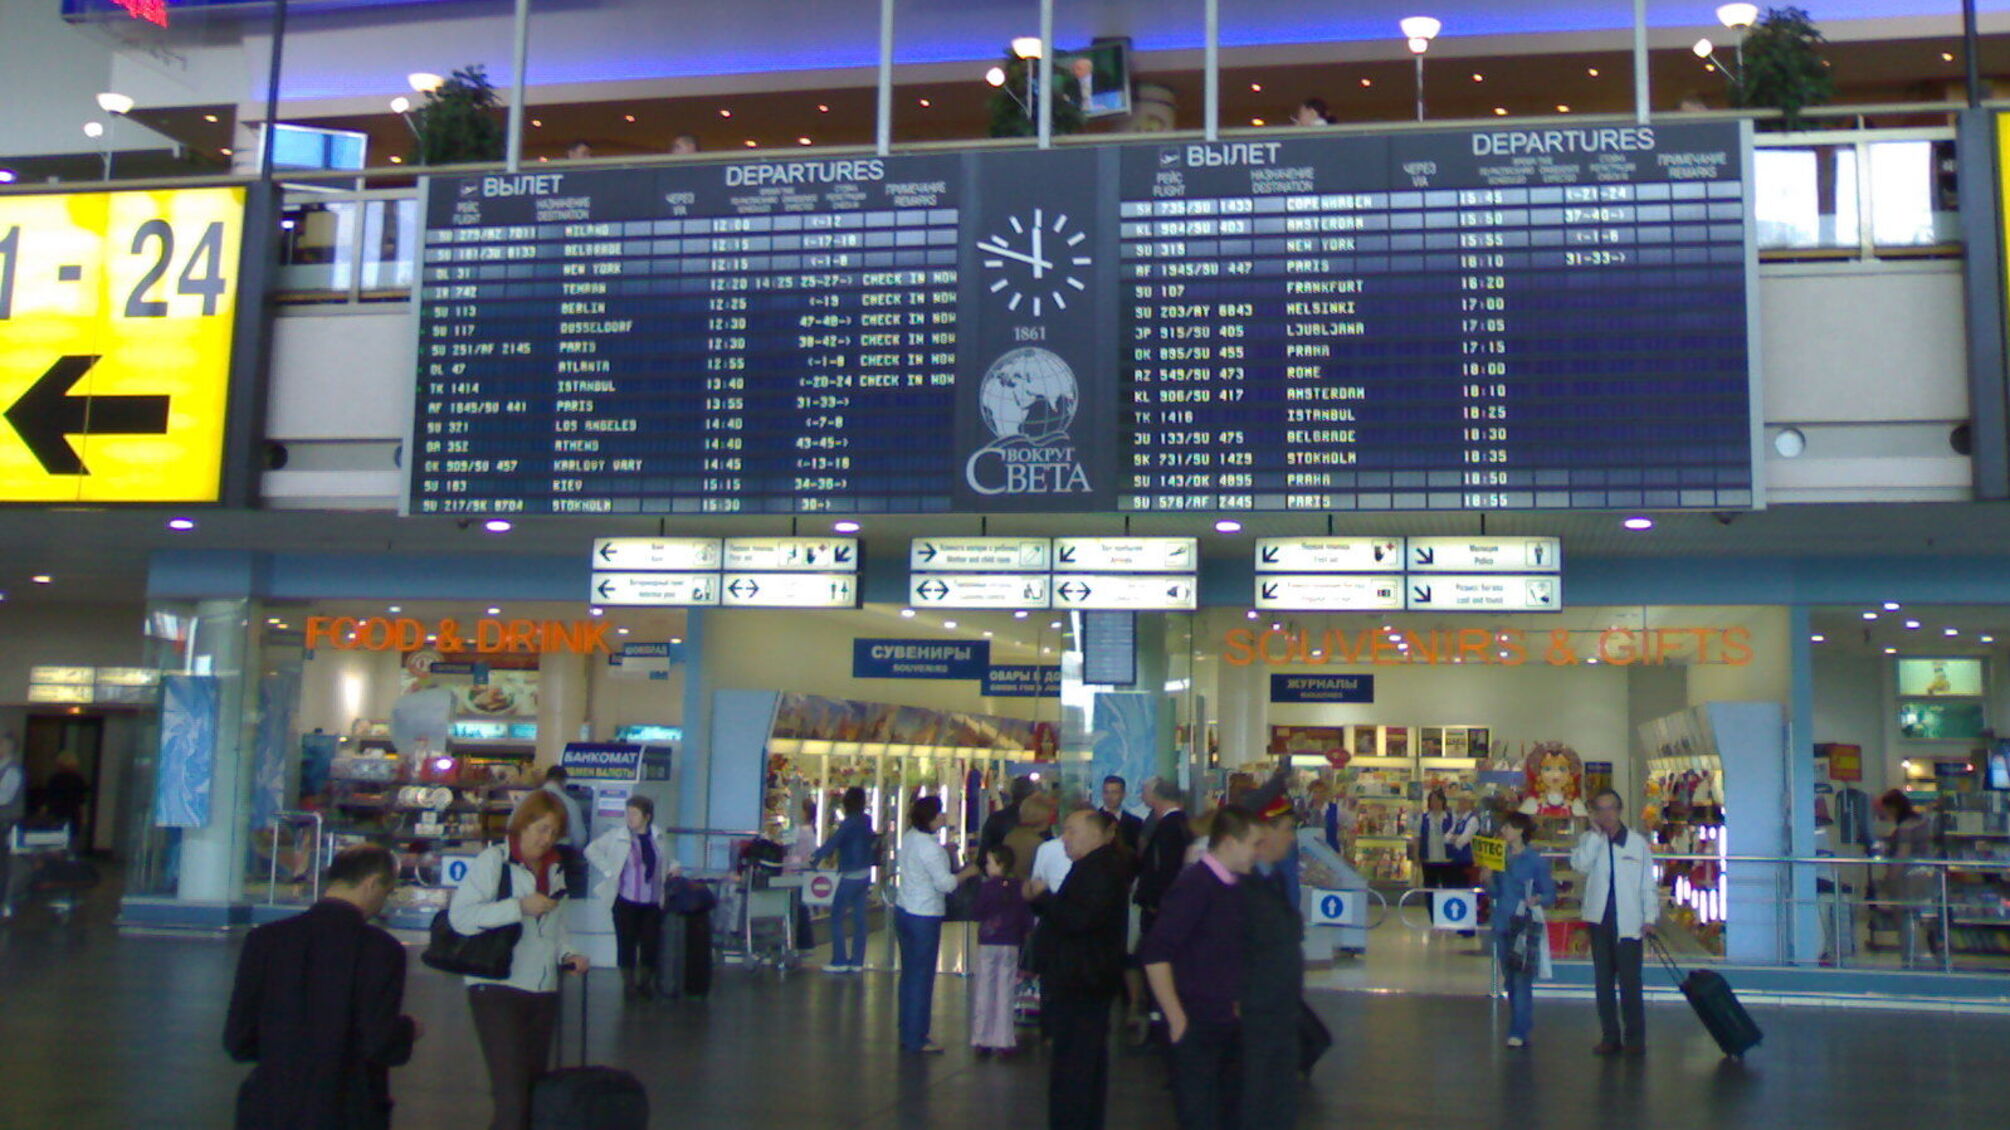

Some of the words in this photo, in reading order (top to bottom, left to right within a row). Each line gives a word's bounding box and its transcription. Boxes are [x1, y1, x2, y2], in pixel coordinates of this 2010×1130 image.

[1472, 128, 1656, 155] DEPARTURES
[1187, 143, 1281, 167] ВЫЛЕТ
[725, 160, 884, 186] DEPARTURES
[483, 174, 563, 197] ВЫЛЕТ
[1135, 244, 1152, 256] SU
[1321, 238, 1355, 251] YORK
[124, 219, 226, 317] 24
[592, 262, 621, 273] YORK
[1135, 265, 1151, 277] AF
[1286, 260, 1329, 273] PARIS
[862, 273, 902, 285] CHECK
[910, 272, 925, 284] IN
[933, 271, 957, 283] NOW
[1135, 285, 1151, 298] SU
[1161, 285, 1184, 297] 107
[1286, 280, 1364, 294] FRANKFURT
[861, 293, 902, 306] CHECK
[909, 292, 925, 304] IN
[933, 291, 957, 304] NOW
[1135, 306, 1151, 318] SU
[1286, 302, 1355, 315] HELSINKI
[1462, 298, 1504, 311] 17:00
[861, 313, 901, 326] CHECK
[909, 313, 924, 324] IN
[932, 312, 956, 324] NOW
[1014, 326, 1046, 341] 1861
[1134, 327, 1151, 339] JP
[1219, 325, 1244, 338] 405
[1286, 323, 1364, 336] LJUBLJANA
[1462, 320, 1504, 332] 17:05
[860, 333, 901, 346] CHECK
[908, 333, 924, 345] IN
[932, 332, 956, 344] NOW
[1462, 341, 1505, 354] 17:15
[860, 354, 900, 366] CHECK
[908, 353, 923, 365] IN
[931, 352, 955, 365] NOW
[1134, 369, 1151, 381] AZ
[1219, 368, 1244, 380] 473
[1286, 366, 1320, 379] ROME
[429, 383, 443, 394] TK
[706, 377, 744, 389] 13:40
[859, 374, 900, 386] CHECK
[907, 374, 923, 385] IN
[931, 373, 955, 385] NOW
[1134, 390, 1151, 402] KL
[1219, 389, 1244, 401] 417
[1286, 387, 1364, 400] AMSTERDAM
[556, 400, 593, 411] PARIS
[705, 397, 744, 409] 13:55
[1134, 411, 1150, 423] TK
[1286, 409, 1356, 422] ISTANBUL
[555, 420, 577, 431] LOS
[704, 418, 743, 429] 14:40
[704, 438, 742, 449] 14:40
[1133, 432, 1150, 445] JU
[1160, 432, 1209, 444] 133/SU
[1218, 431, 1244, 444] 475
[1286, 430, 1356, 443] BELGRADE
[1007, 448, 1075, 462] ВОКРУГ
[1133, 454, 1150, 466] SK
[703, 458, 742, 470] 14:45
[965, 448, 1093, 495] СВЕТА
[702, 478, 741, 490] 15:15
[1133, 475, 1150, 487] SU
[1159, 474, 1209, 487] 143/OK
[1286, 473, 1329, 486] PRAHA
[1133, 496, 1150, 508] SU
[1286, 495, 1329, 508] PARIS
[306, 615, 425, 651] FOOD
[433, 616, 465, 651] &
[477, 617, 613, 654] DRINK
[871, 645, 971, 660] СУВЕНИРЫ
[1223, 627, 1528, 667] SOUVENIRS
[1546, 628, 1580, 666] &
[1599, 626, 1755, 667] GIFTS
[1287, 678, 1358, 689] ЖУРНАЛЫ
[564, 751, 639, 764] БАНКОМАТ
